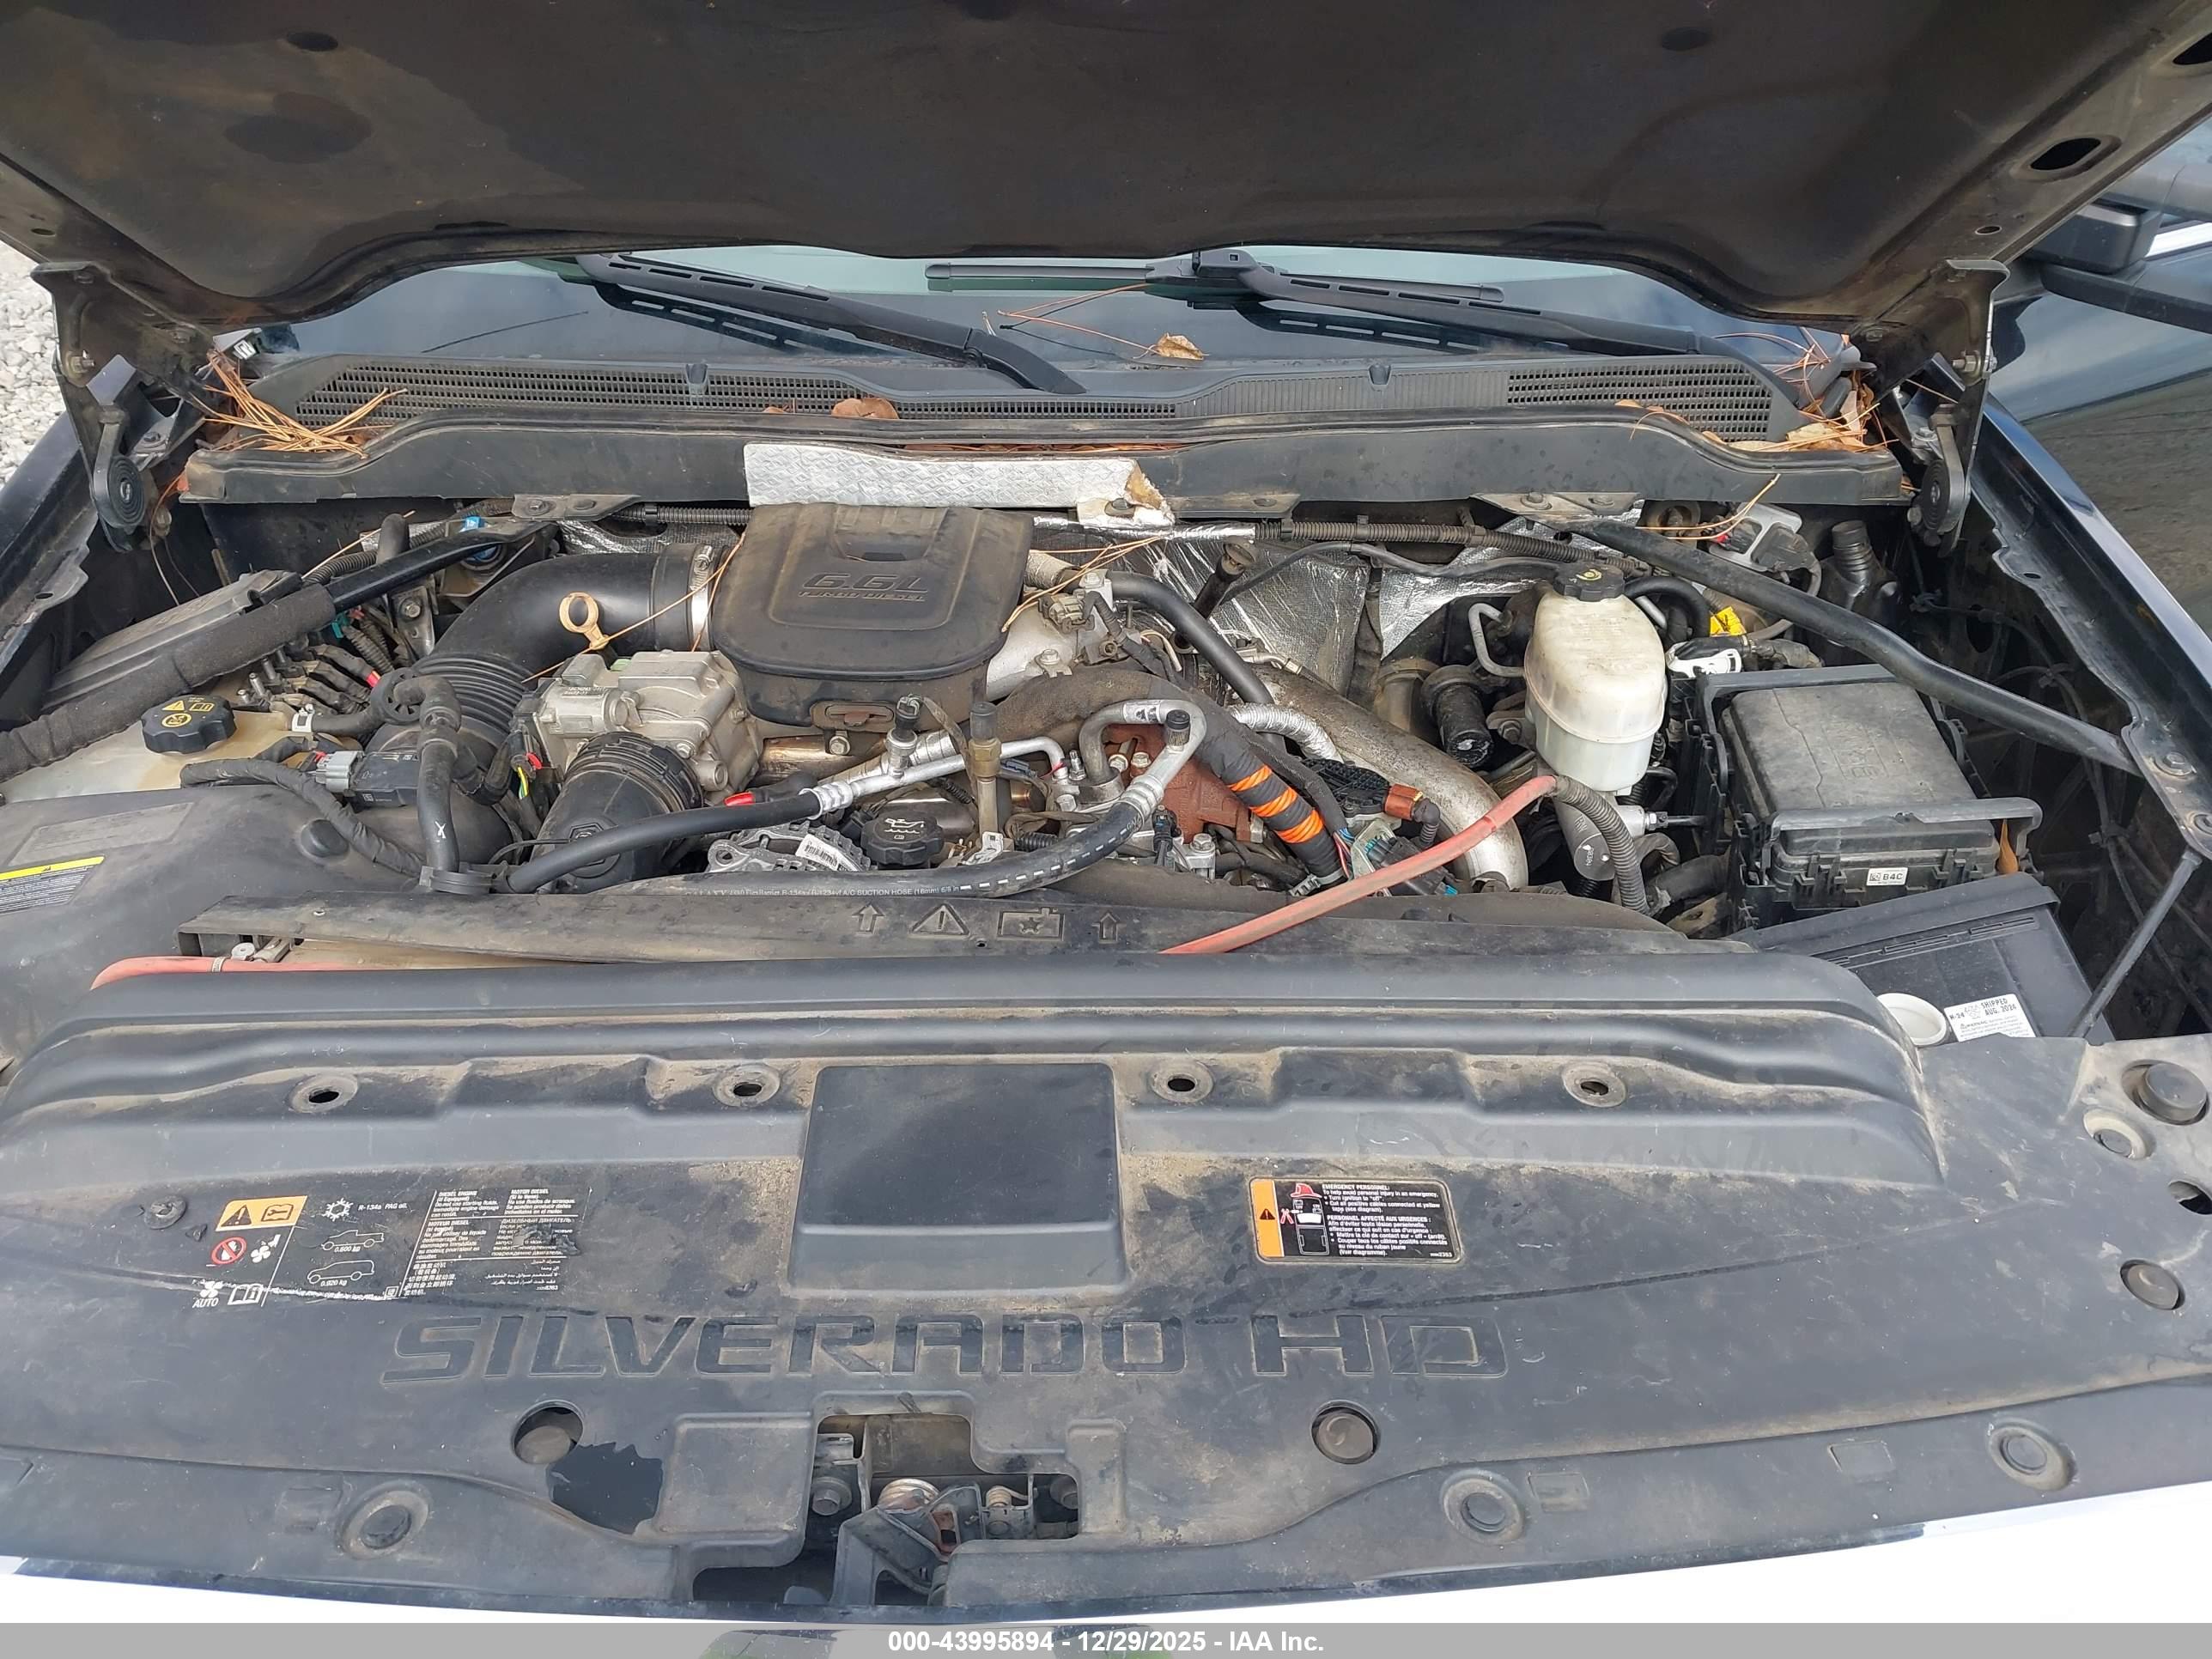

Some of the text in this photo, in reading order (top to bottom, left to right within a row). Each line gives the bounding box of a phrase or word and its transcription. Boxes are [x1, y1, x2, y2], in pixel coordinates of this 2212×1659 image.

[803, 572, 927, 593] 6.6L
[891, 887, 913, 896] HOSE
[1980, 998, 2008, 1009] SHIPPED
[1984, 1007, 2000, 1017] AUG.
[2000, 1004, 2017, 1013] 2024
[191, 1297, 219, 1309] AUTO
[381, 1314, 1508, 1383] SILVERADO HD
